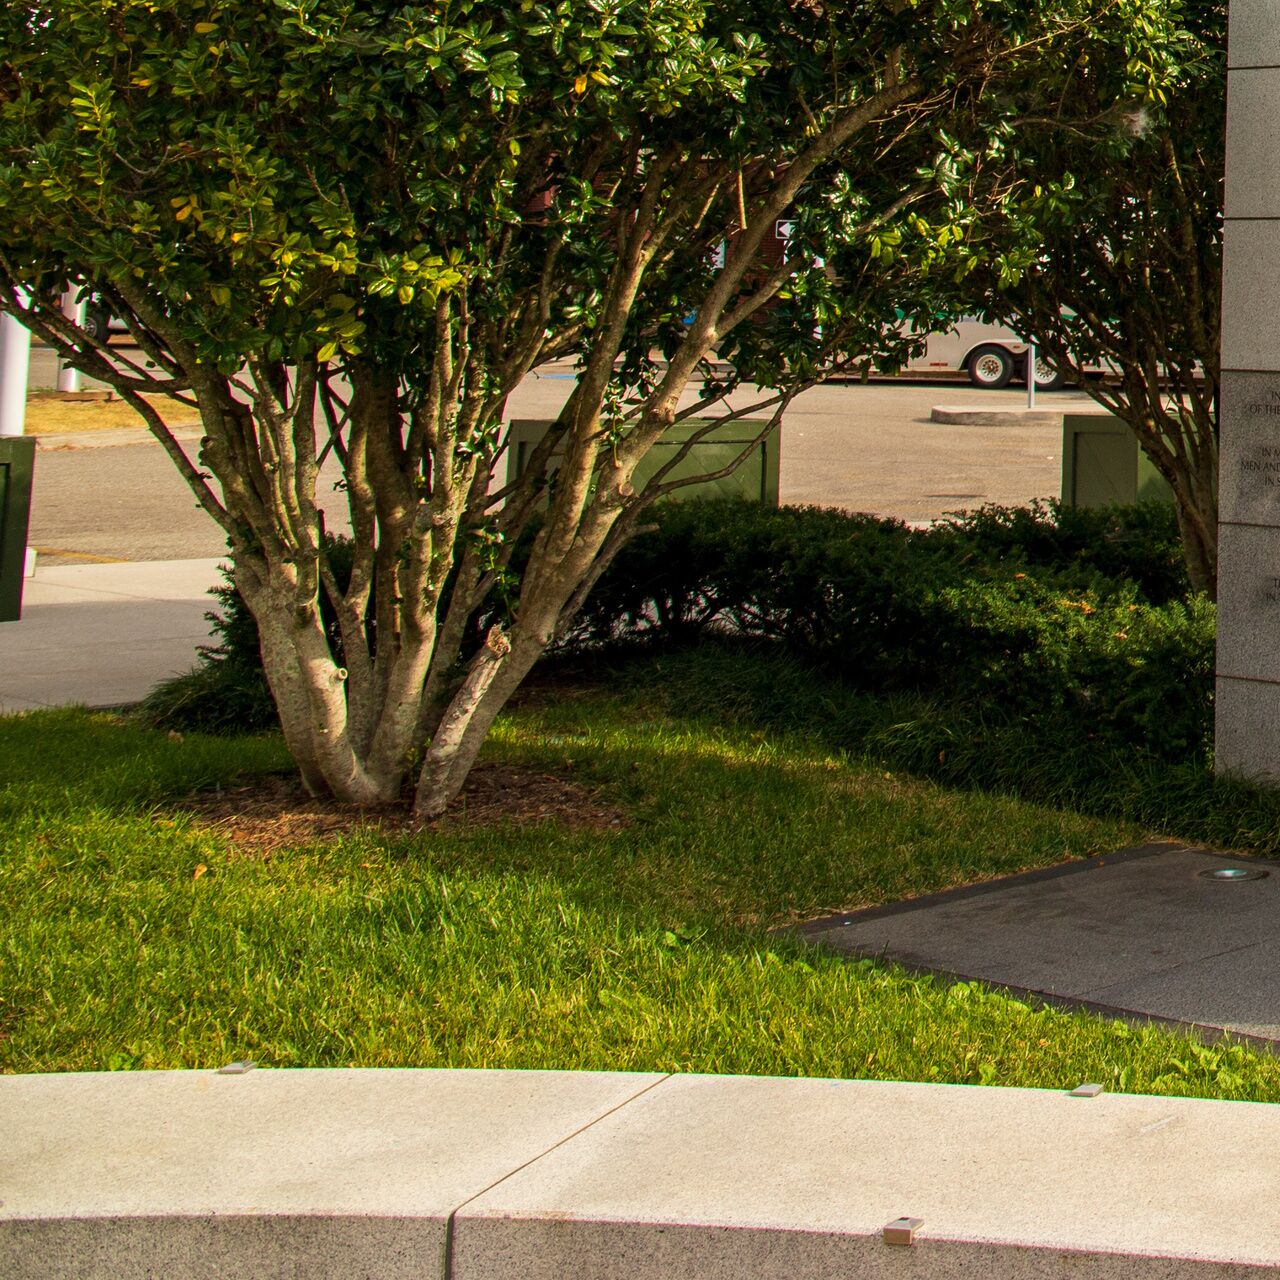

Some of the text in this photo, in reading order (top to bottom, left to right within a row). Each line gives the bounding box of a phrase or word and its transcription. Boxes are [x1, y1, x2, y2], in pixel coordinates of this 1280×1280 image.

[1271, 391, 1280, 401] IN
[1250, 404, 1263, 414] OF
[1265, 405, 1280, 415] THE
[1261, 448, 1271, 457] IN
[1241, 460, 1261, 471] MEN
[1264, 476, 1275, 487] IN
[1266, 592, 1276, 602] IN
